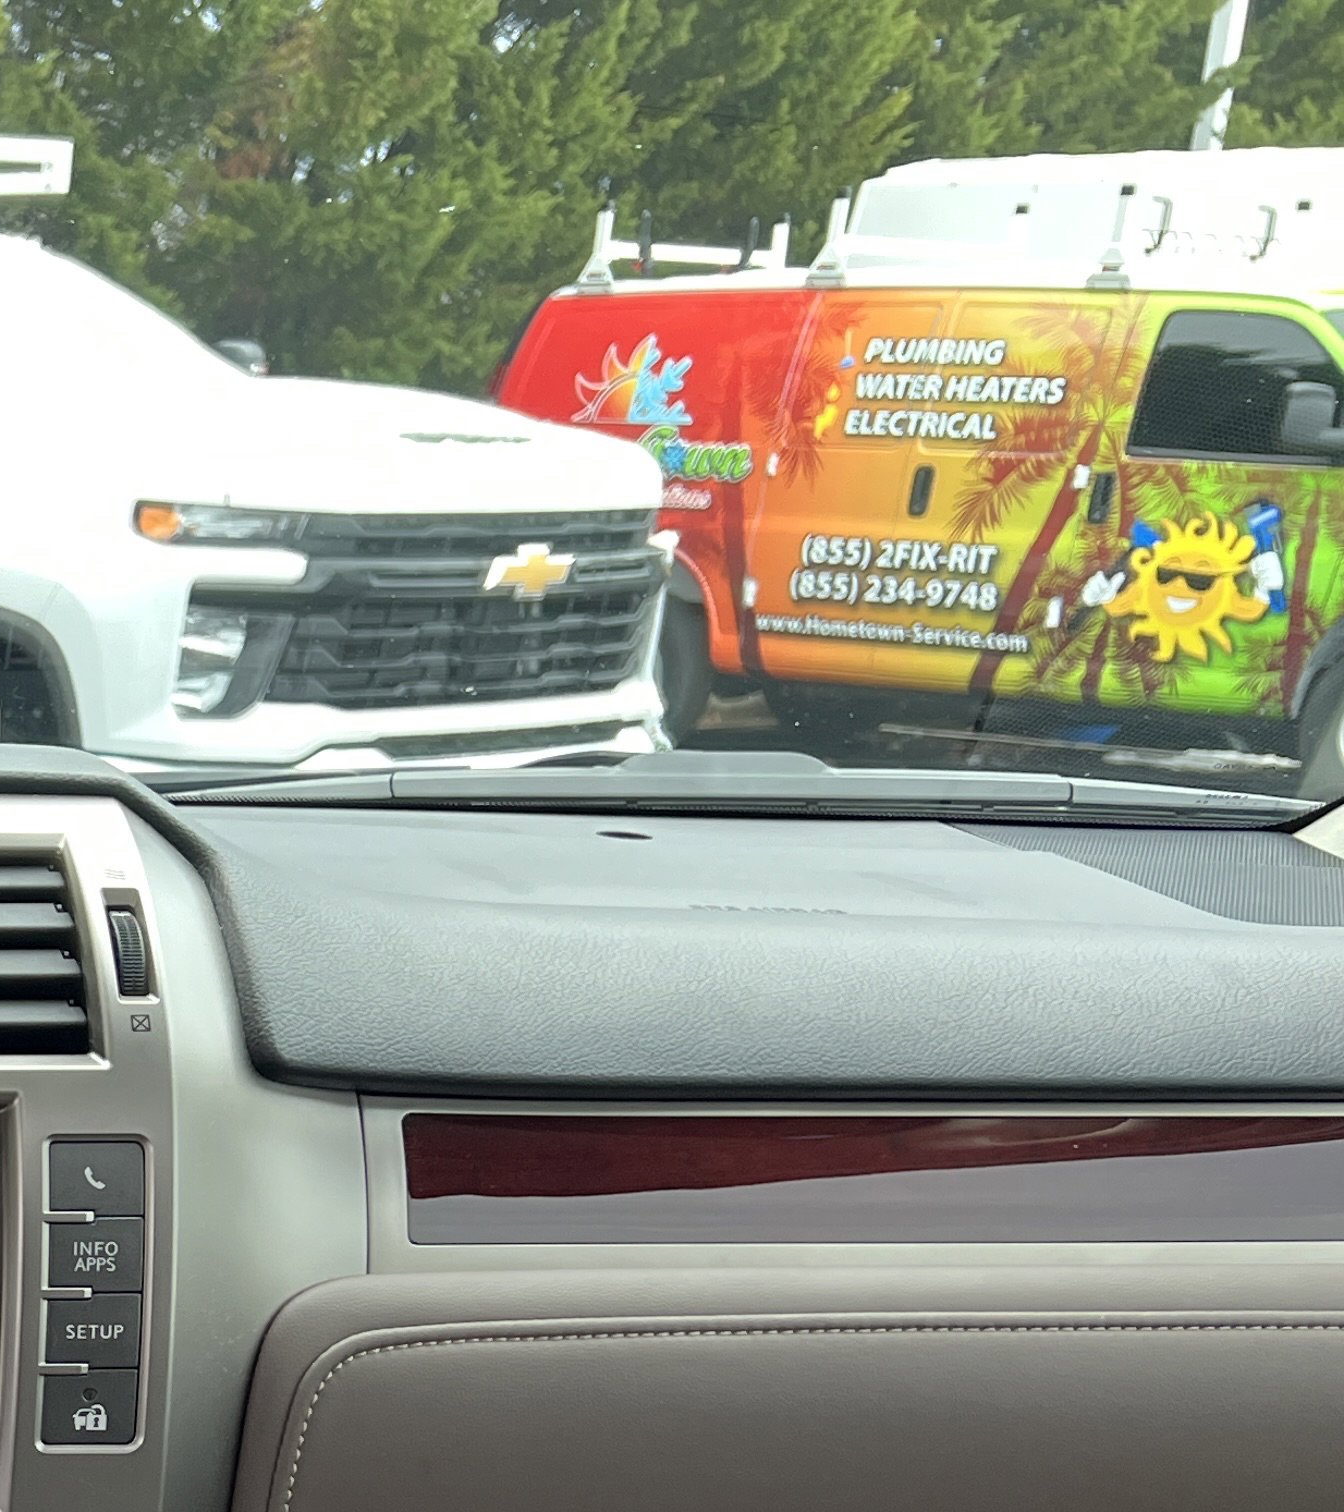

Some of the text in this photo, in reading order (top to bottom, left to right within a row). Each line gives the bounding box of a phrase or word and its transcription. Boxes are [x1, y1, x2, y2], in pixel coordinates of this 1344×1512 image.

[863, 337, 1007, 366] PLUMBING
[855, 373, 1067, 405] WATER HEATERS
[843, 408, 998, 440] ELECTRICAL
[801, 532, 998, 575] (855) 2FIX-RIT
[788, 567, 998, 612] (855) 234-9748
[72, 1241, 119, 1257] INFO
[73, 1257, 117, 1273] APPS
[65, 1324, 125, 1340] SETUP
